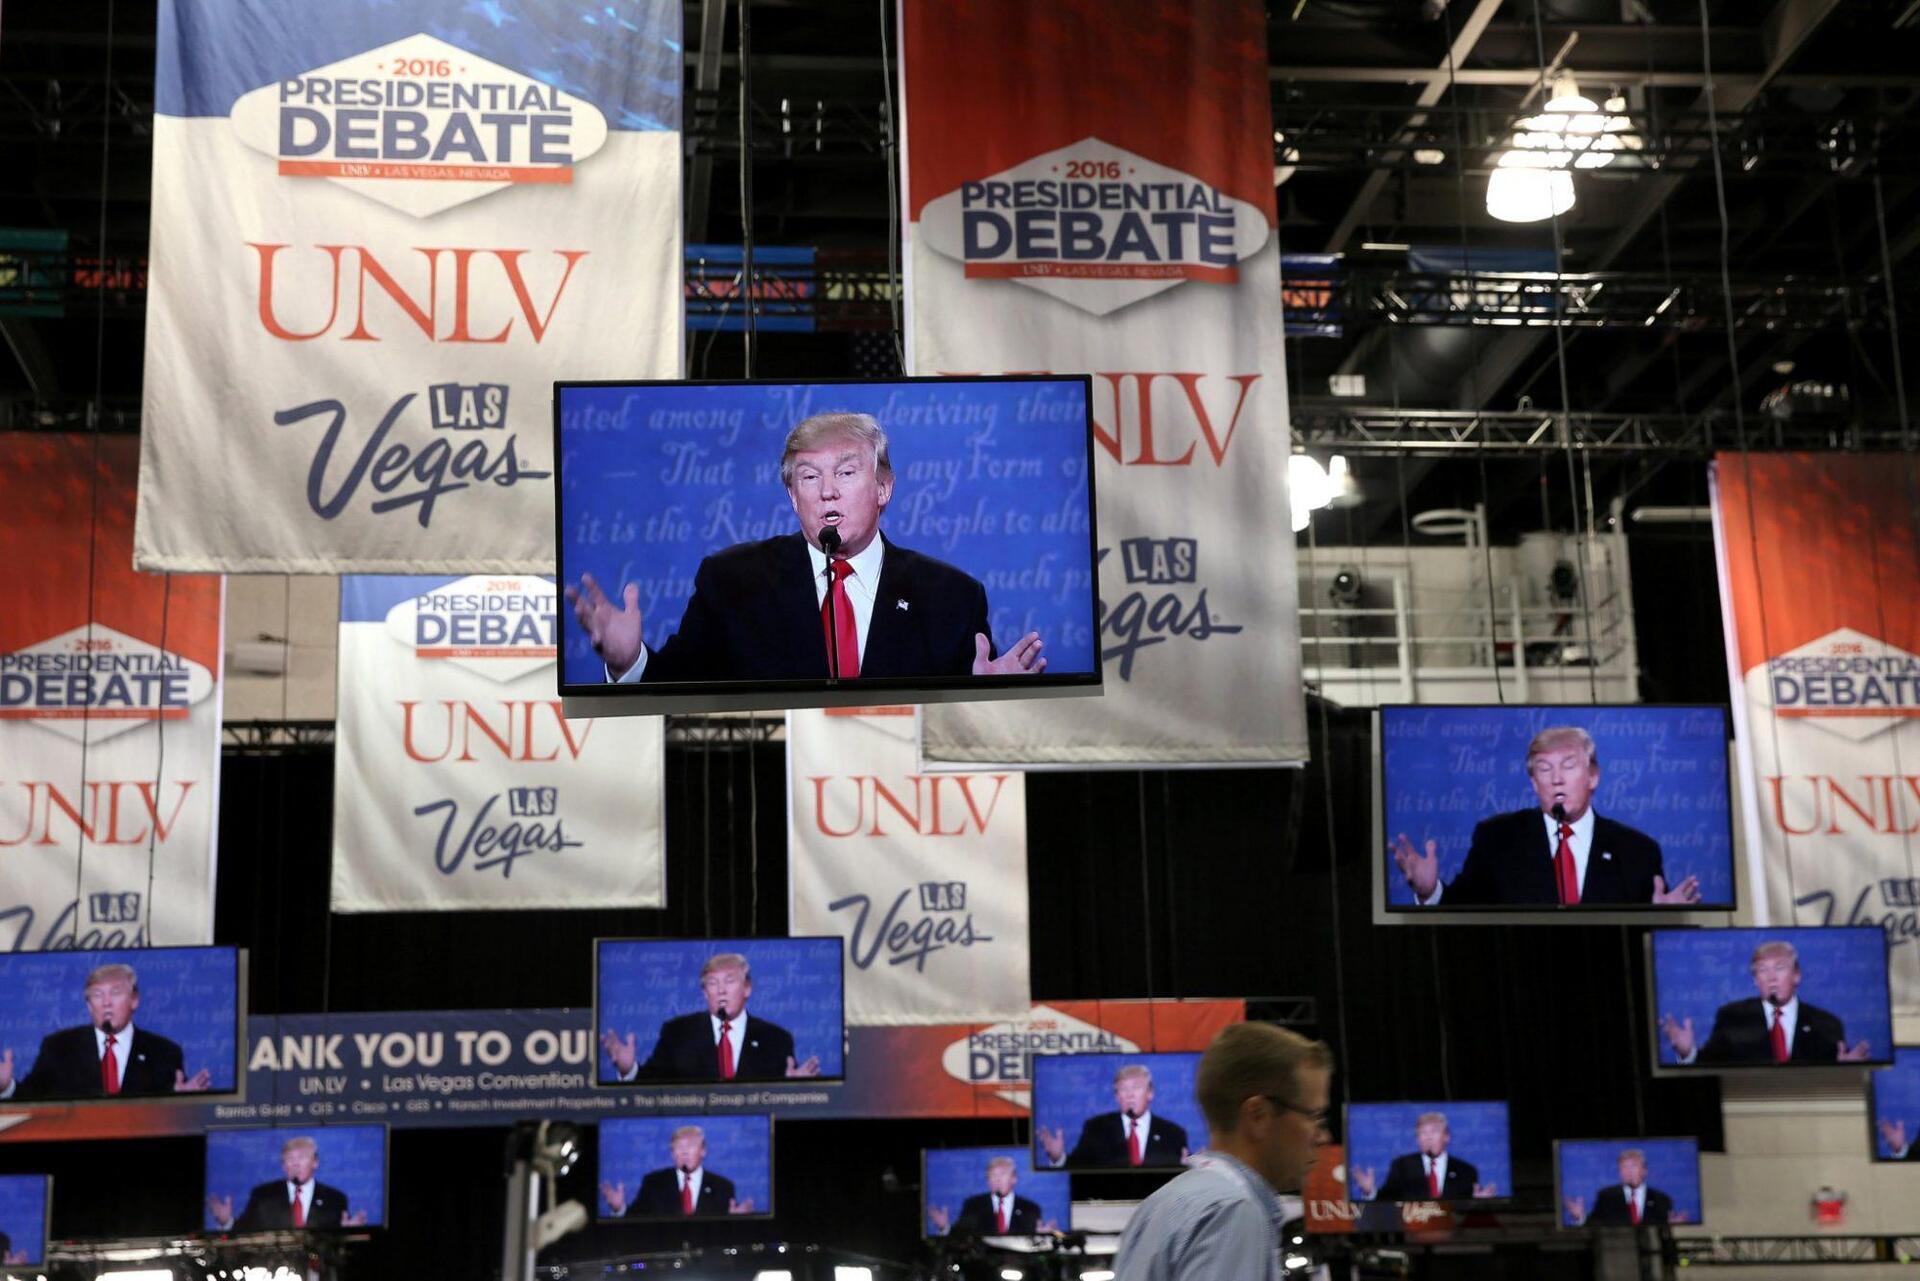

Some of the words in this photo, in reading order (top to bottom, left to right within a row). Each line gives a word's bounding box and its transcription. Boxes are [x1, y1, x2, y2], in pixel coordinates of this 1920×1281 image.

[393, 59, 450, 76] 2016
[280, 78, 571, 112] PRESIDENTIAL
[279, 107, 573, 164] DEBATE
[384, 166, 409, 177] LAS
[461, 168, 511, 179] NEVADA
[1066, 161, 1121, 178] 2016
[961, 181, 1234, 214] PRESIDENTIAL
[963, 209, 1238, 265] DEBATE
[242, 241, 592, 344] UNLV
[432, 385, 506, 428] LAS
[878, 389, 998, 440] deriving
[650, 408, 745, 447] among
[274, 393, 552, 528] Vegas
[659, 441, 735, 486] That
[907, 456, 963, 498] any
[964, 433, 1043, 480] Form
[576, 510, 601, 544] it
[610, 510, 638, 544] is
[645, 504, 694, 544] the
[900, 481, 996, 550] People
[1004, 507, 1032, 534] to
[1124, 540, 1194, 582] LAS
[486, 580, 521, 592] 2016
[0, 654, 188, 672] PRESIDENTIAL
[0, 674, 189, 706] DEBATE
[511, 790, 555, 815] LAS
[808, 775, 1009, 838] UNLV
[414, 794, 584, 878] Vegas
[91, 894, 138, 920] LAS
[922, 884, 965, 910] LAS
[829, 889, 993, 972] Vegas
[353, 1031, 444, 1069] YOU
[455, 1030, 512, 1066] TO
[968, 1033, 1122, 1051] PRESIDENTIAL
[299, 1075, 347, 1095] UNLV
[383, 1074, 414, 1093] Las
[416, 1073, 475, 1096] Vegas
[477, 1071, 585, 1091] Convention
